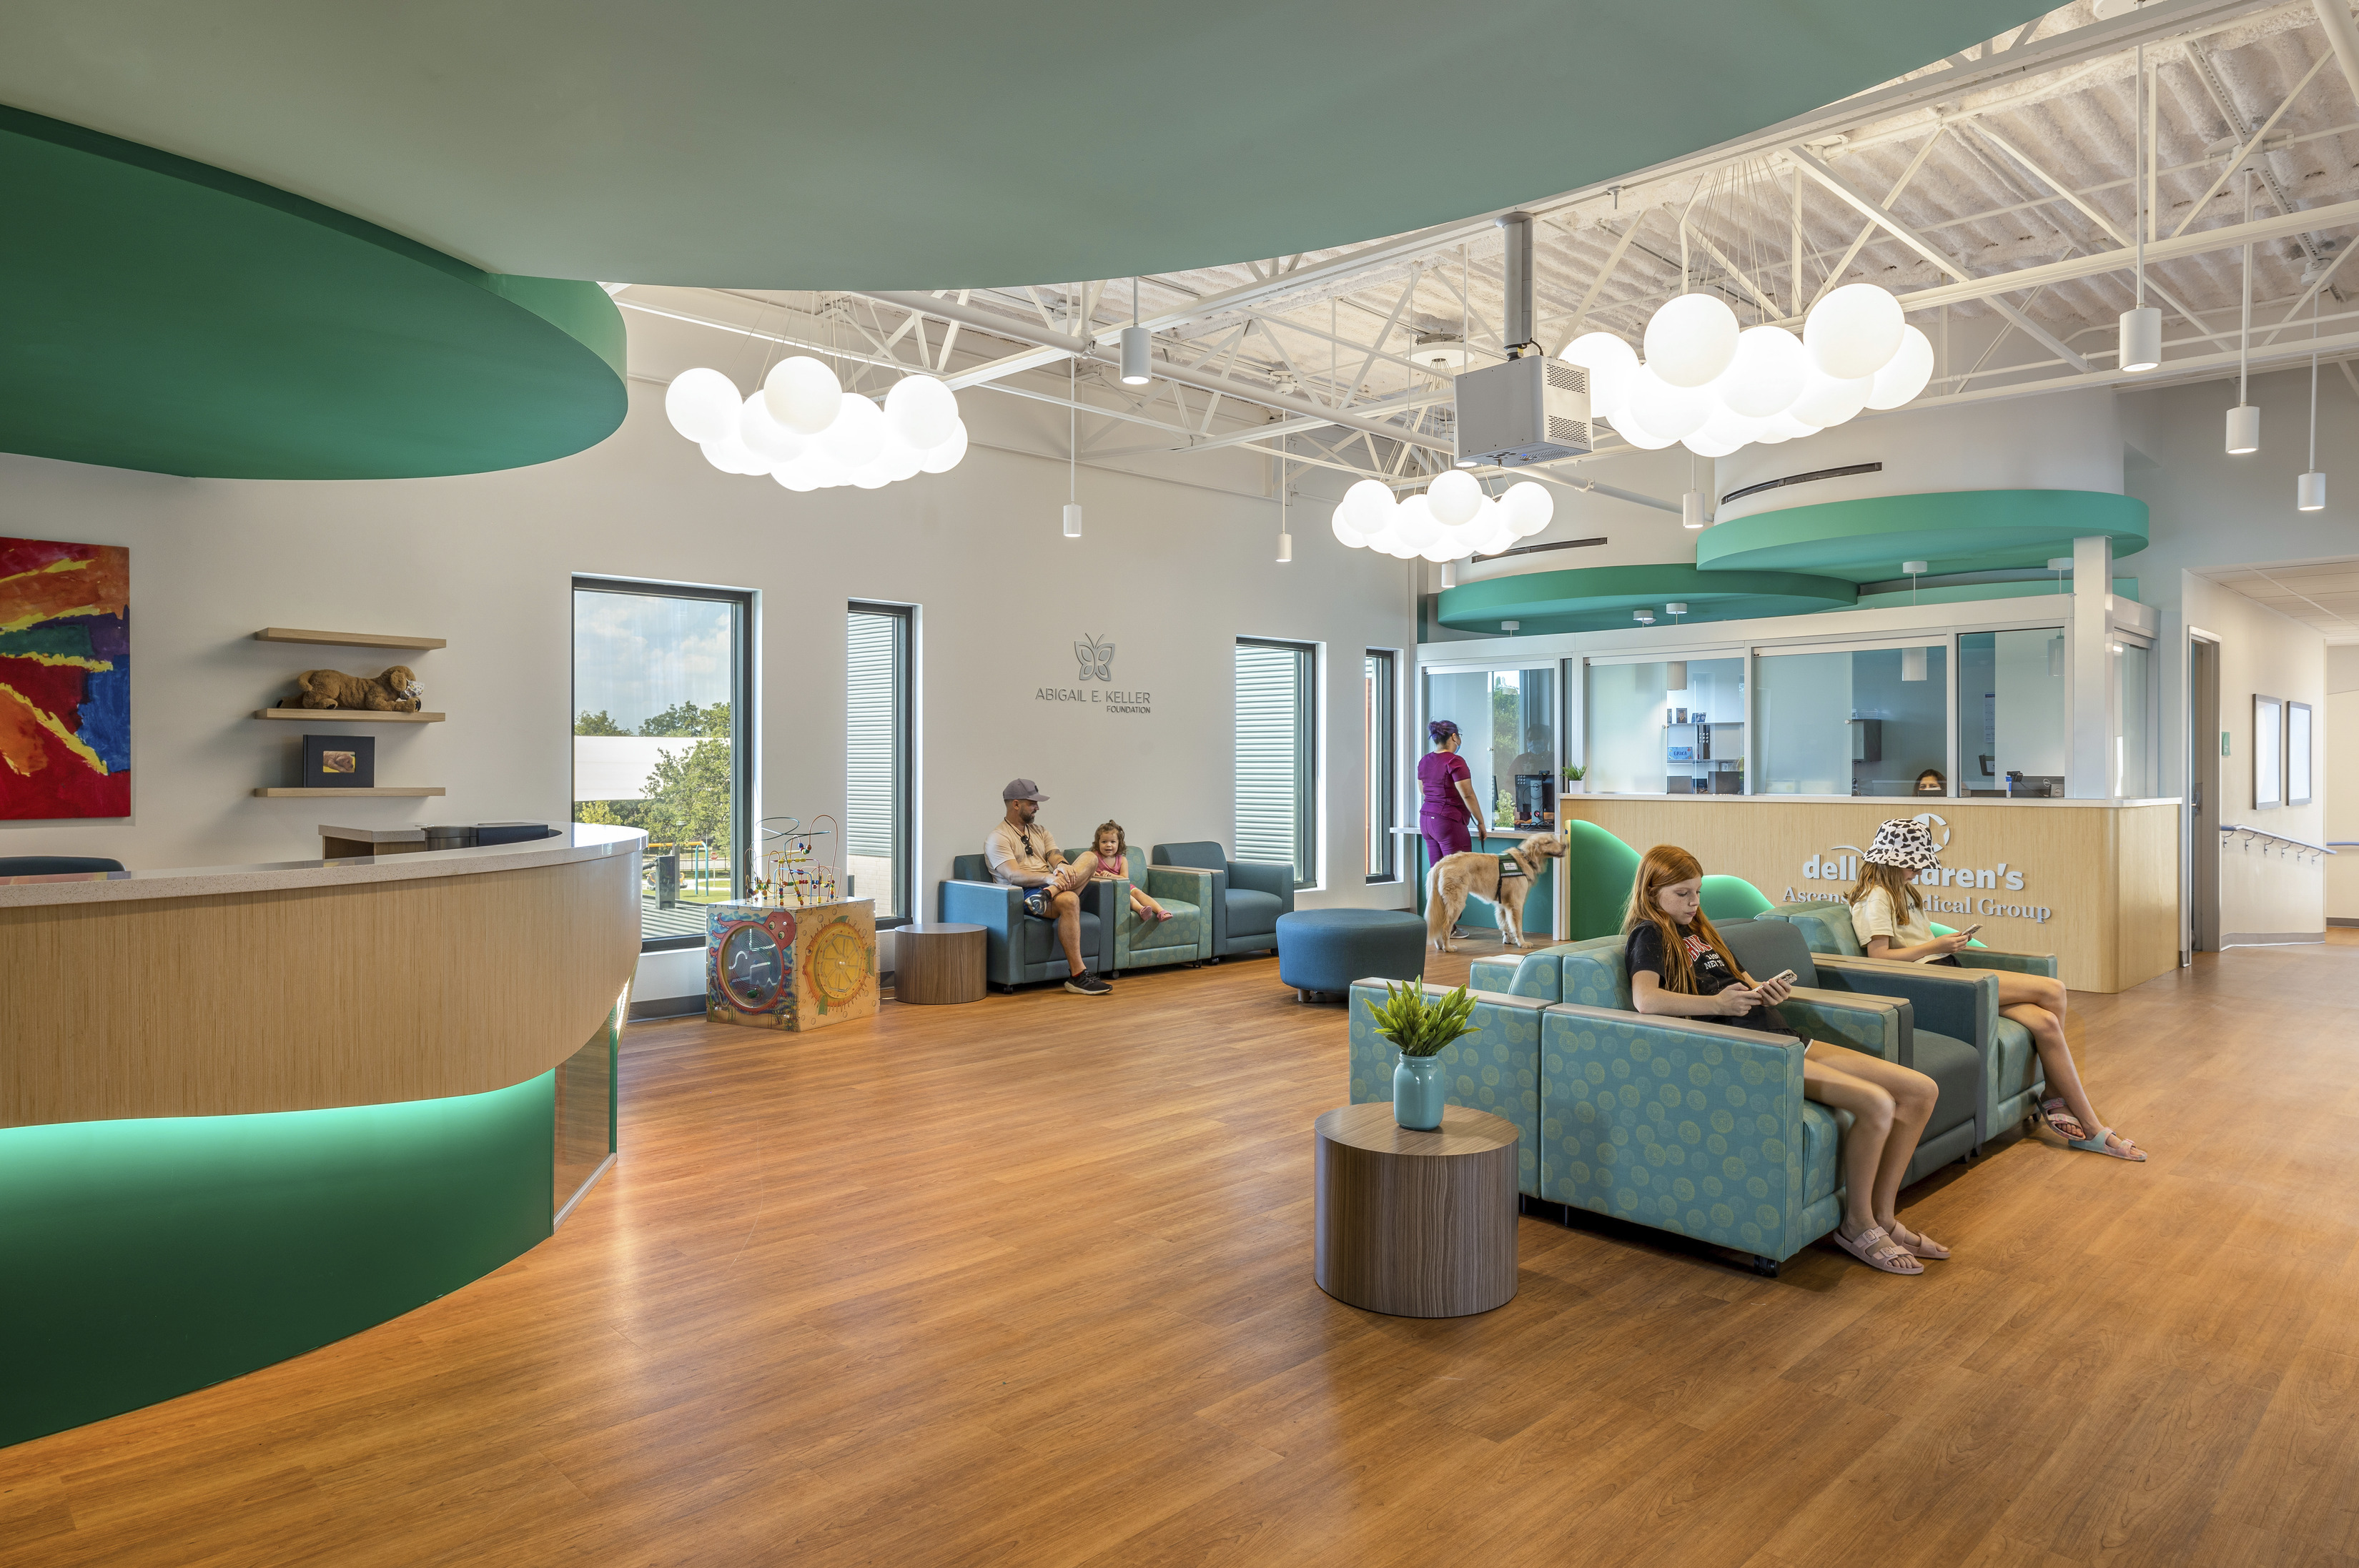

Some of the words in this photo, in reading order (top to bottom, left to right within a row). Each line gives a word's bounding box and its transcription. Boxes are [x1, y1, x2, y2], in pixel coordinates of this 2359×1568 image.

[1034, 688, 1087, 702] ABIGAIL
[1091, 690, 1102, 703] E.
[1106, 690, 1151, 704] KELLER
[1802, 854, 1857, 881] dell
[1977, 898, 2052, 924] Group
